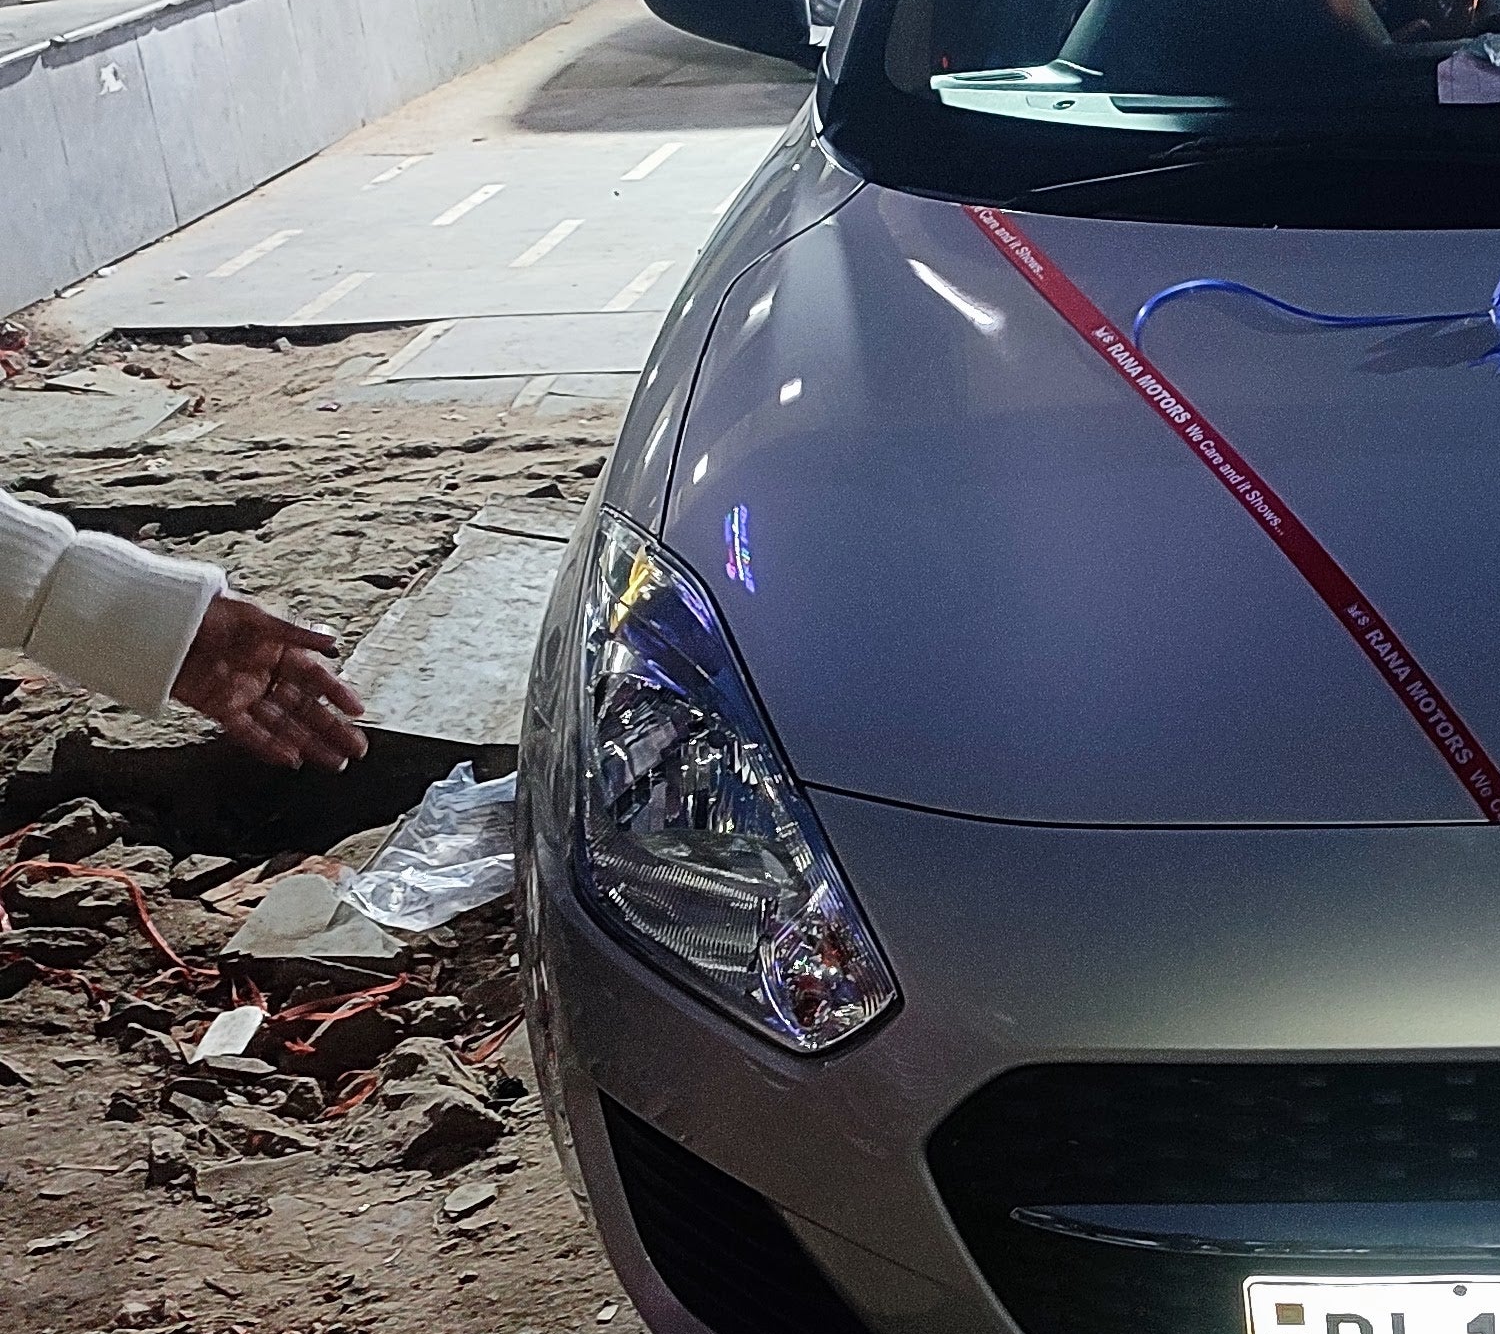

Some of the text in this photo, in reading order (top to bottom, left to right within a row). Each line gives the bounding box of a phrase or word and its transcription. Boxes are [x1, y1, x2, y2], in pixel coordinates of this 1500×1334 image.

[1107, 342, 1143, 377] RANA
[1136, 374, 1191, 423] MOTORS
[1200, 440, 1224, 465] Care
[1219, 463, 1245, 485] and
[1365, 628, 1411, 682] RANA
[1405, 680, 1474, 765] MOTORS
[1469, 768, 1493, 798] We
